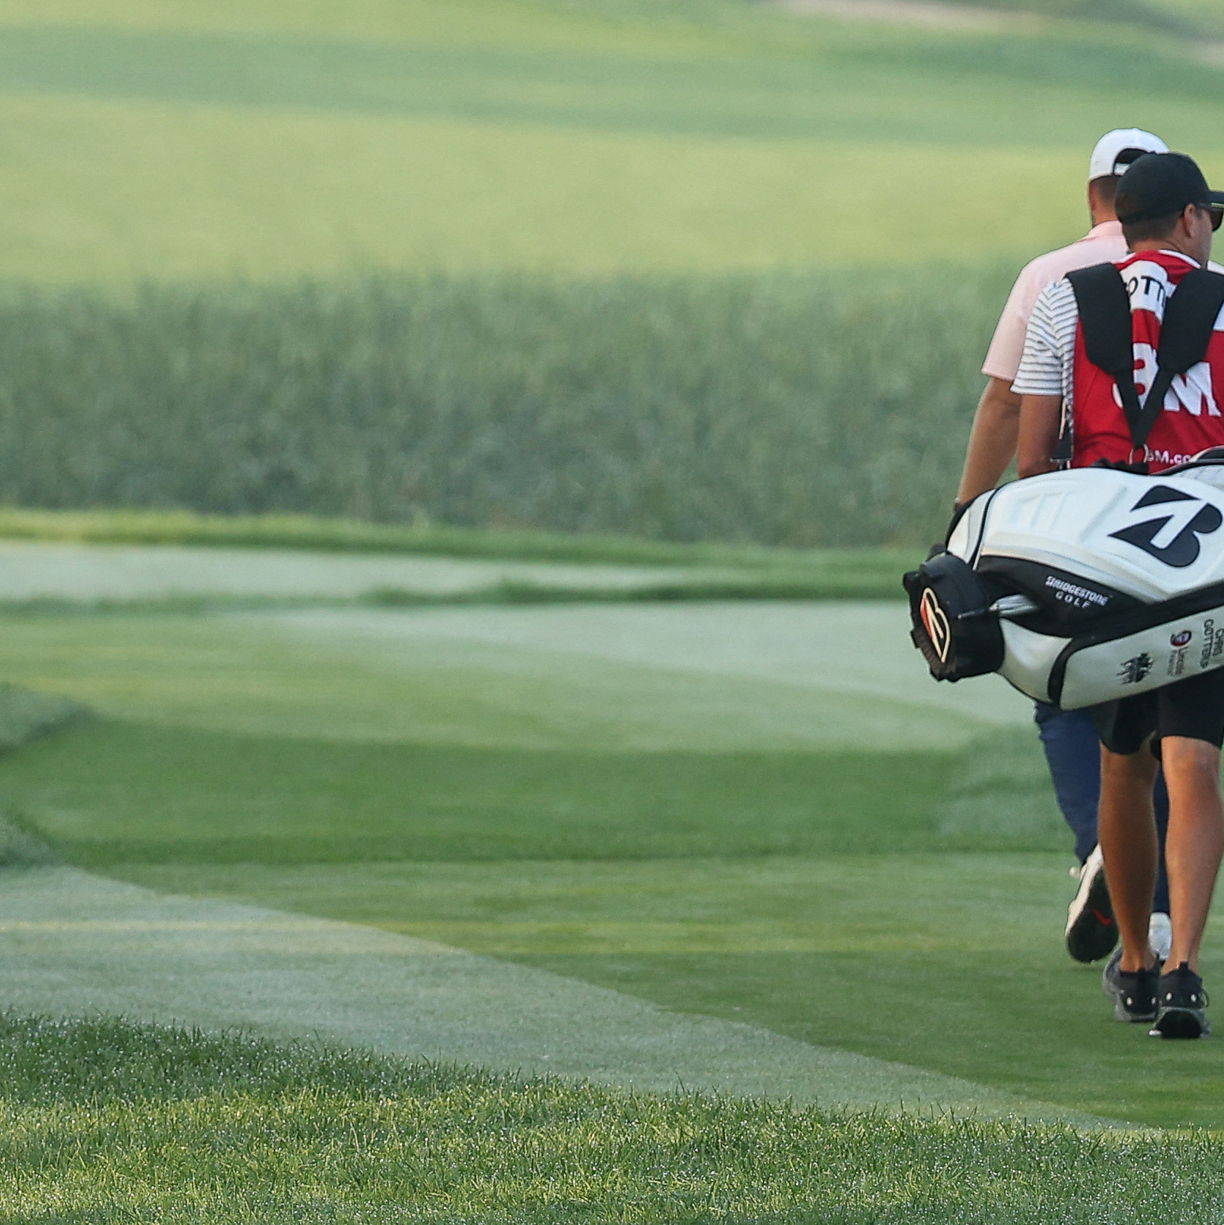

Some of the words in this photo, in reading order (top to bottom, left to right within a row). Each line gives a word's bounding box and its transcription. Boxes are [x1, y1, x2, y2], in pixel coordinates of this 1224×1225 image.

[1147, 449, 1195, 465] 3M.co
[1044, 575, 1110, 607] BRIDGESTONE
[1055, 590, 1092, 609] GOLF
